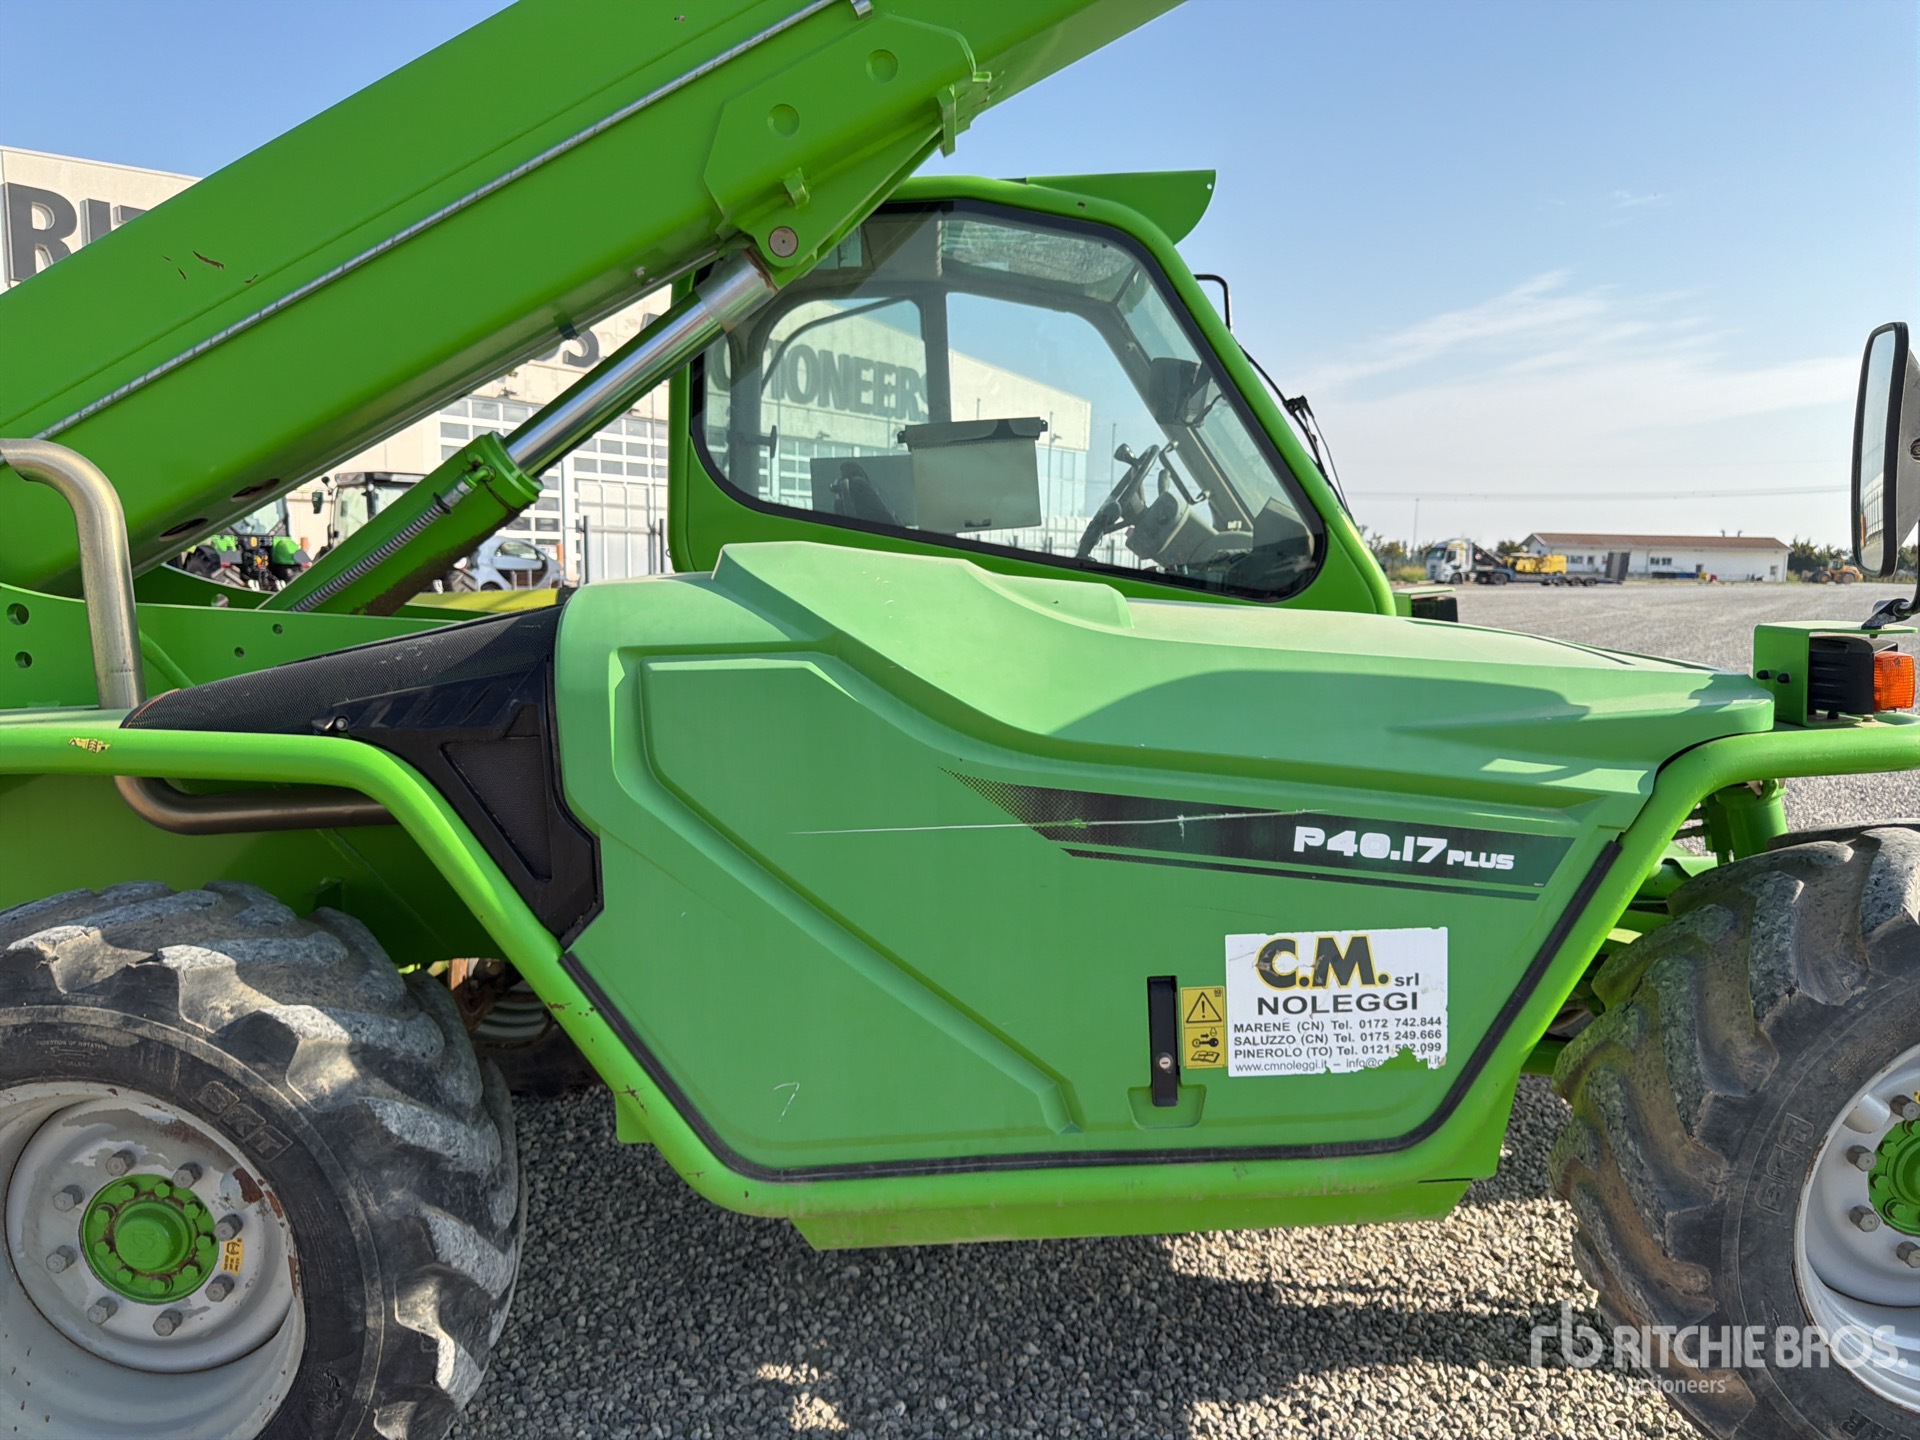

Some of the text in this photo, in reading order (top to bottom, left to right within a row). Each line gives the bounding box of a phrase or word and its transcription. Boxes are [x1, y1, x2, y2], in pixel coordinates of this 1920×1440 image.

[1446, 849, 1515, 870] PLUS
[1255, 933, 1419, 991] C.M. srl
[1257, 992, 1418, 1015] NOLEGGI
[1233, 1016, 1442, 1034] MARENE (CN) Tel. 0172 742.844
[1234, 1029, 1442, 1046] SALUZZO (CN) Tel. 0175 249.666
[1234, 1047, 1303, 1059] PINEROLO
[1306, 1046, 1333, 1059] (TO)
[1336, 1046, 1358, 1056] Tel.
[1361, 1044, 1390, 1055] 0121
[1235, 1060, 1327, 1072] www.cmnoleggi.it
